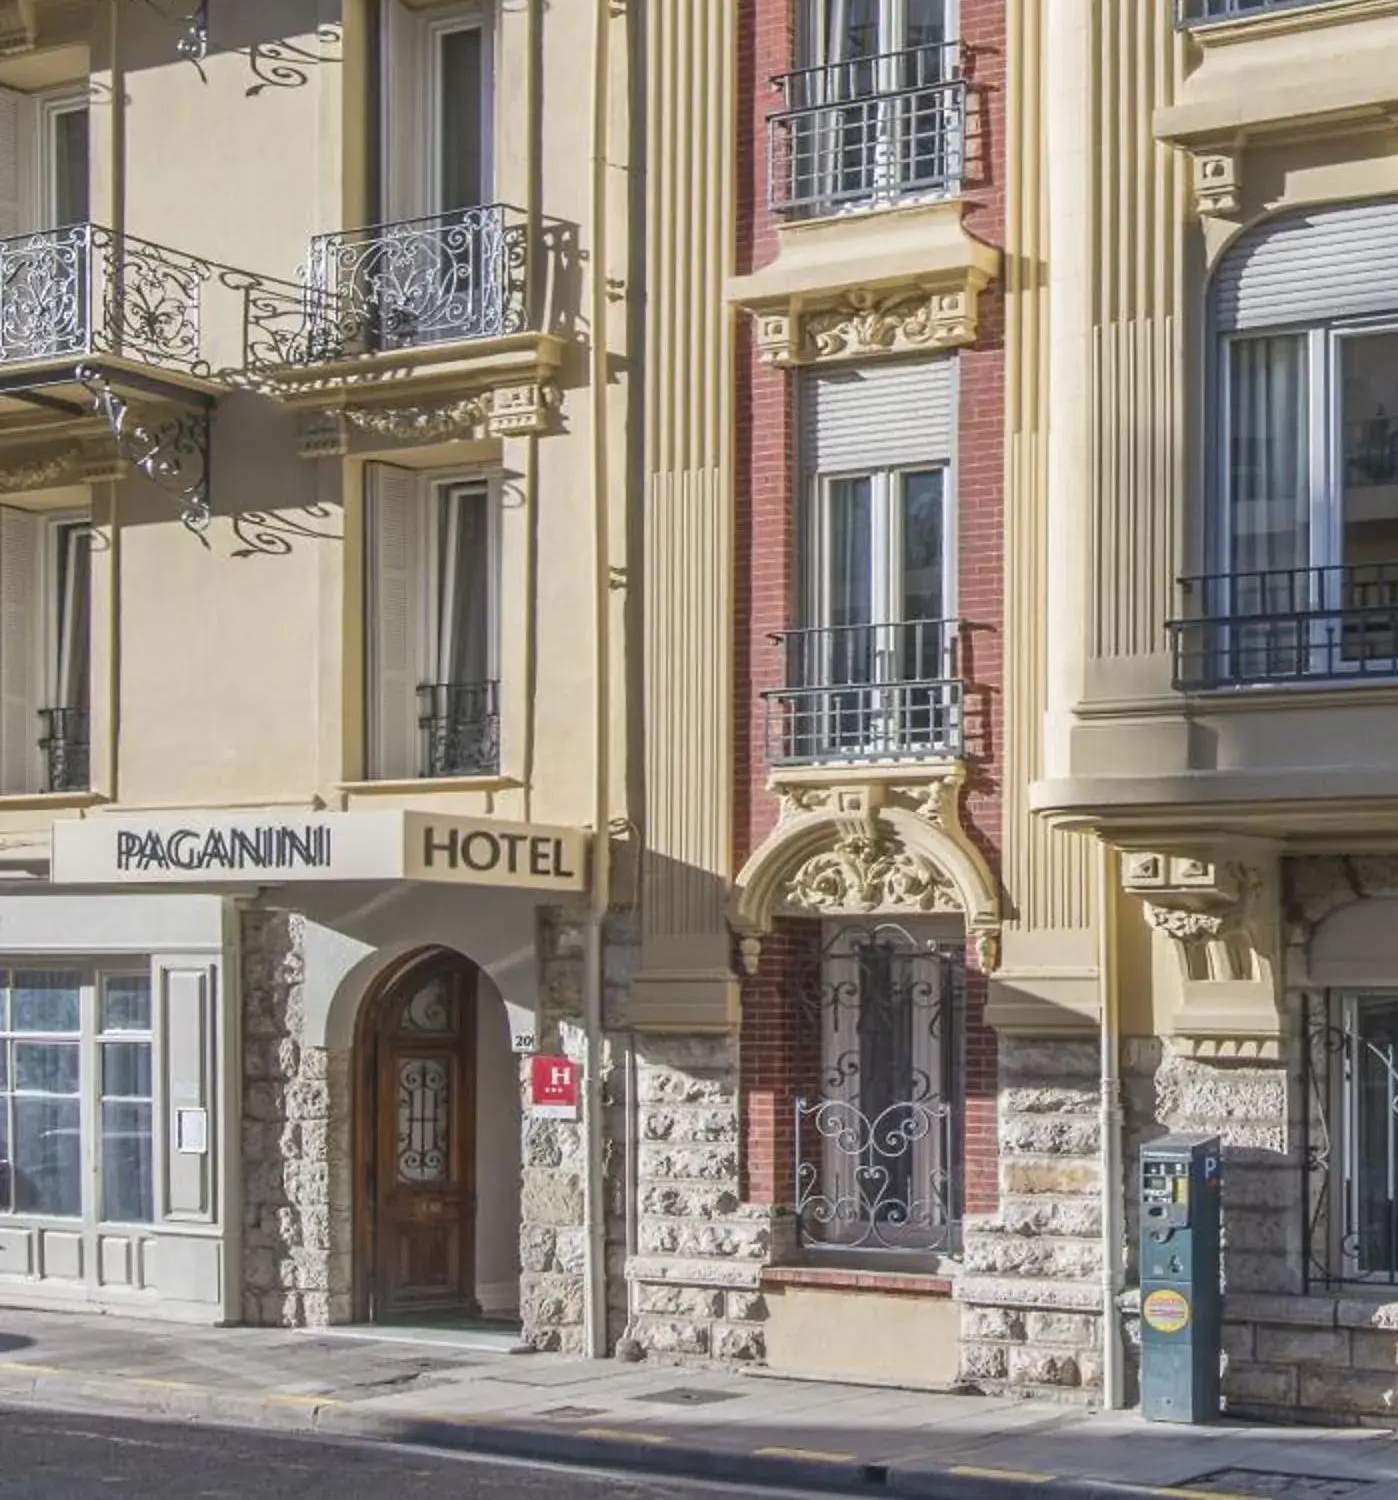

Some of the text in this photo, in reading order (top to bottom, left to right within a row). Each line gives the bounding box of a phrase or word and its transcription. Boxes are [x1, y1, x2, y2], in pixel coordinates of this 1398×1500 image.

[117, 825, 331, 870] PAGANINI
[424, 826, 575, 878] HOTEL
[551, 1067, 571, 1085] H
[1205, 1156, 1217, 1180] P
